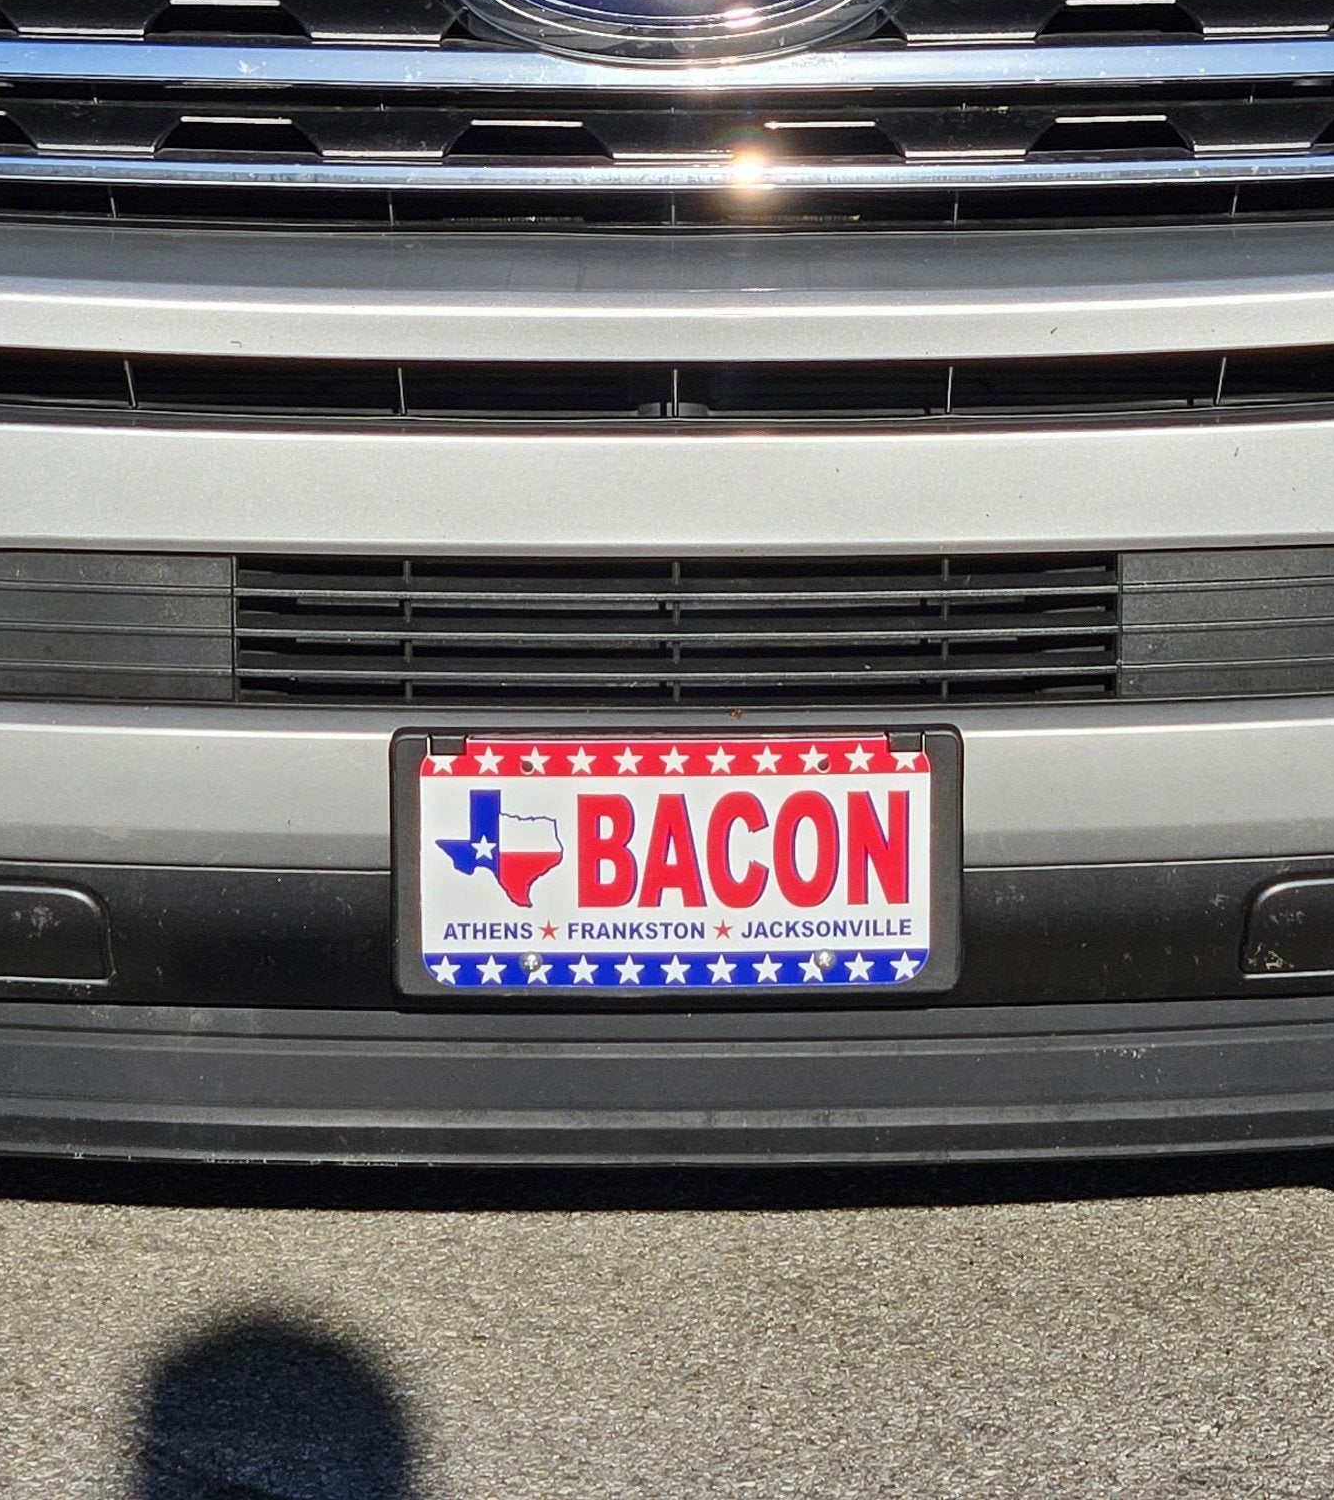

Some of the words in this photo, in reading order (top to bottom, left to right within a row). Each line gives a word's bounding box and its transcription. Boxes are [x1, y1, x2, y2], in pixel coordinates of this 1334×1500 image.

[577, 790, 910, 909] BACON
[443, 922, 533, 941] ATHENS
[568, 922, 705, 940] FRANKSTON
[741, 919, 912, 939] JACKSONVILLE
